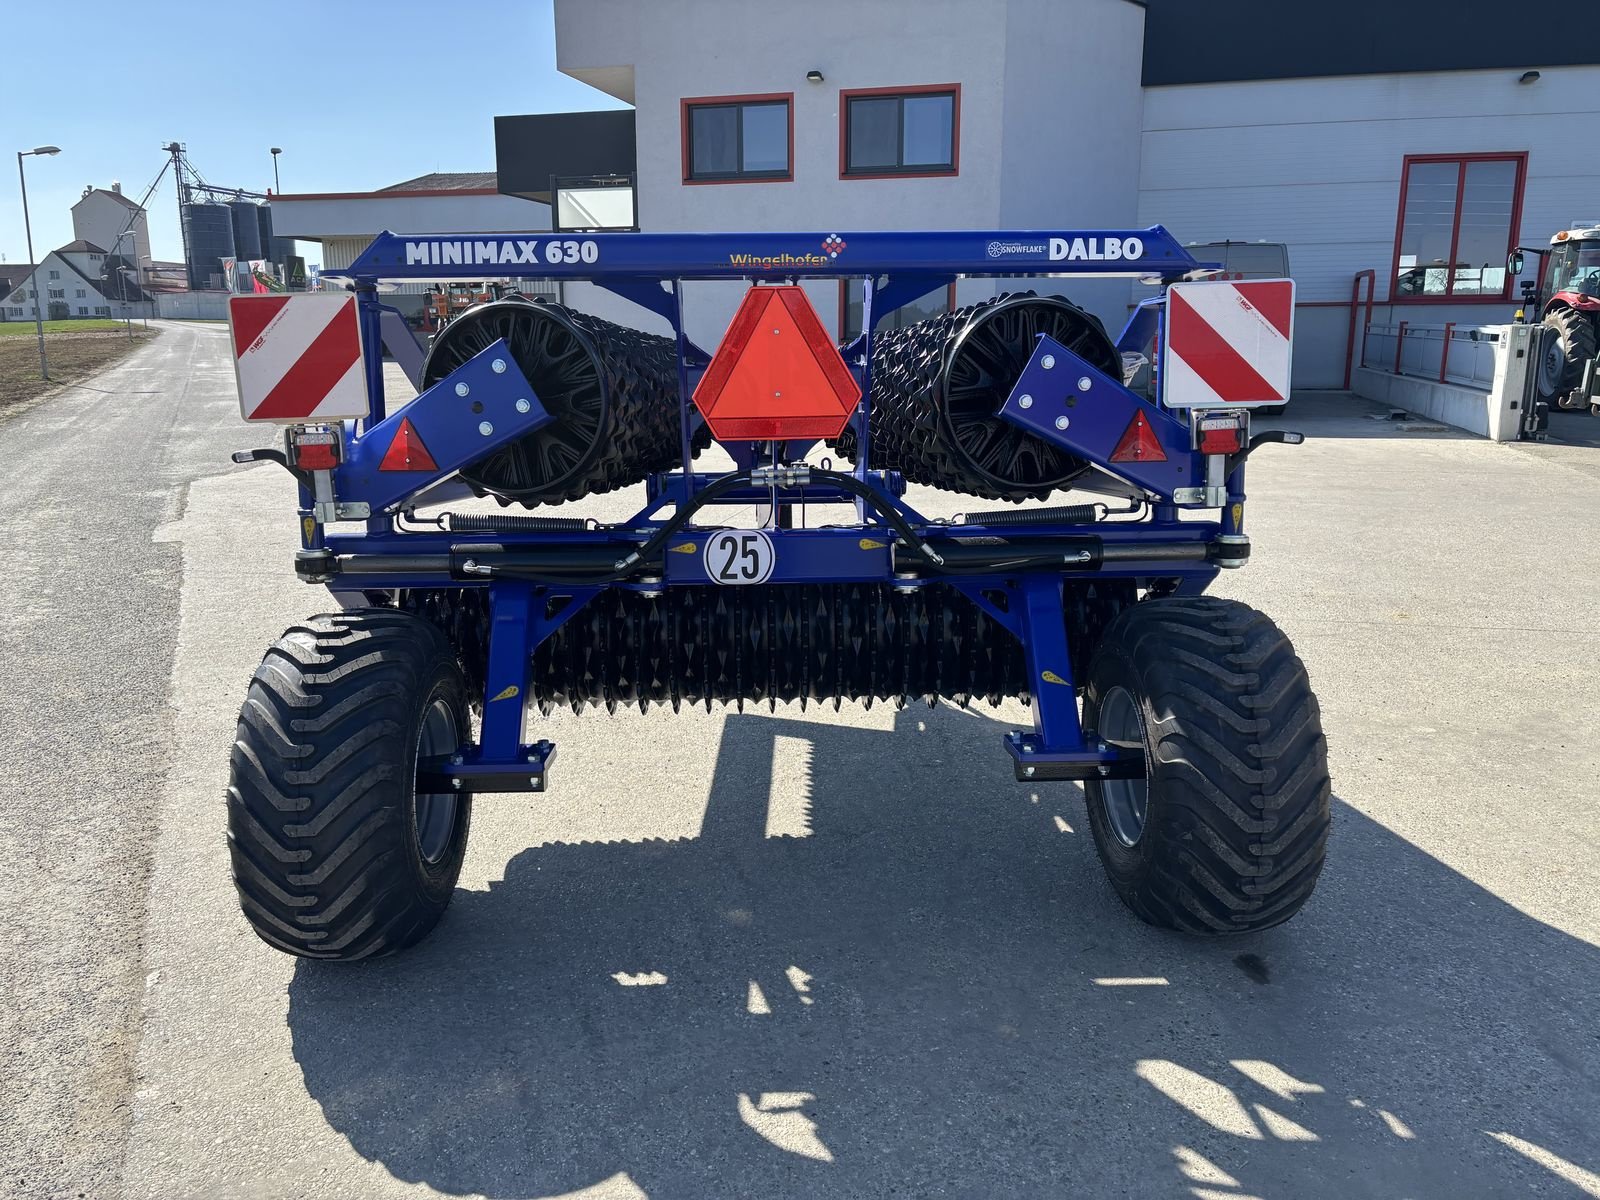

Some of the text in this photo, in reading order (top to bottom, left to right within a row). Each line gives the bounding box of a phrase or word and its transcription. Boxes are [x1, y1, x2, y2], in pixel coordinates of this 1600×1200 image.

[406, 241, 599, 265] MINIMAX 630
[1049, 237, 1143, 261] DALBO
[729, 253, 828, 270] Wingelhofer
[719, 535, 760, 580] 25
